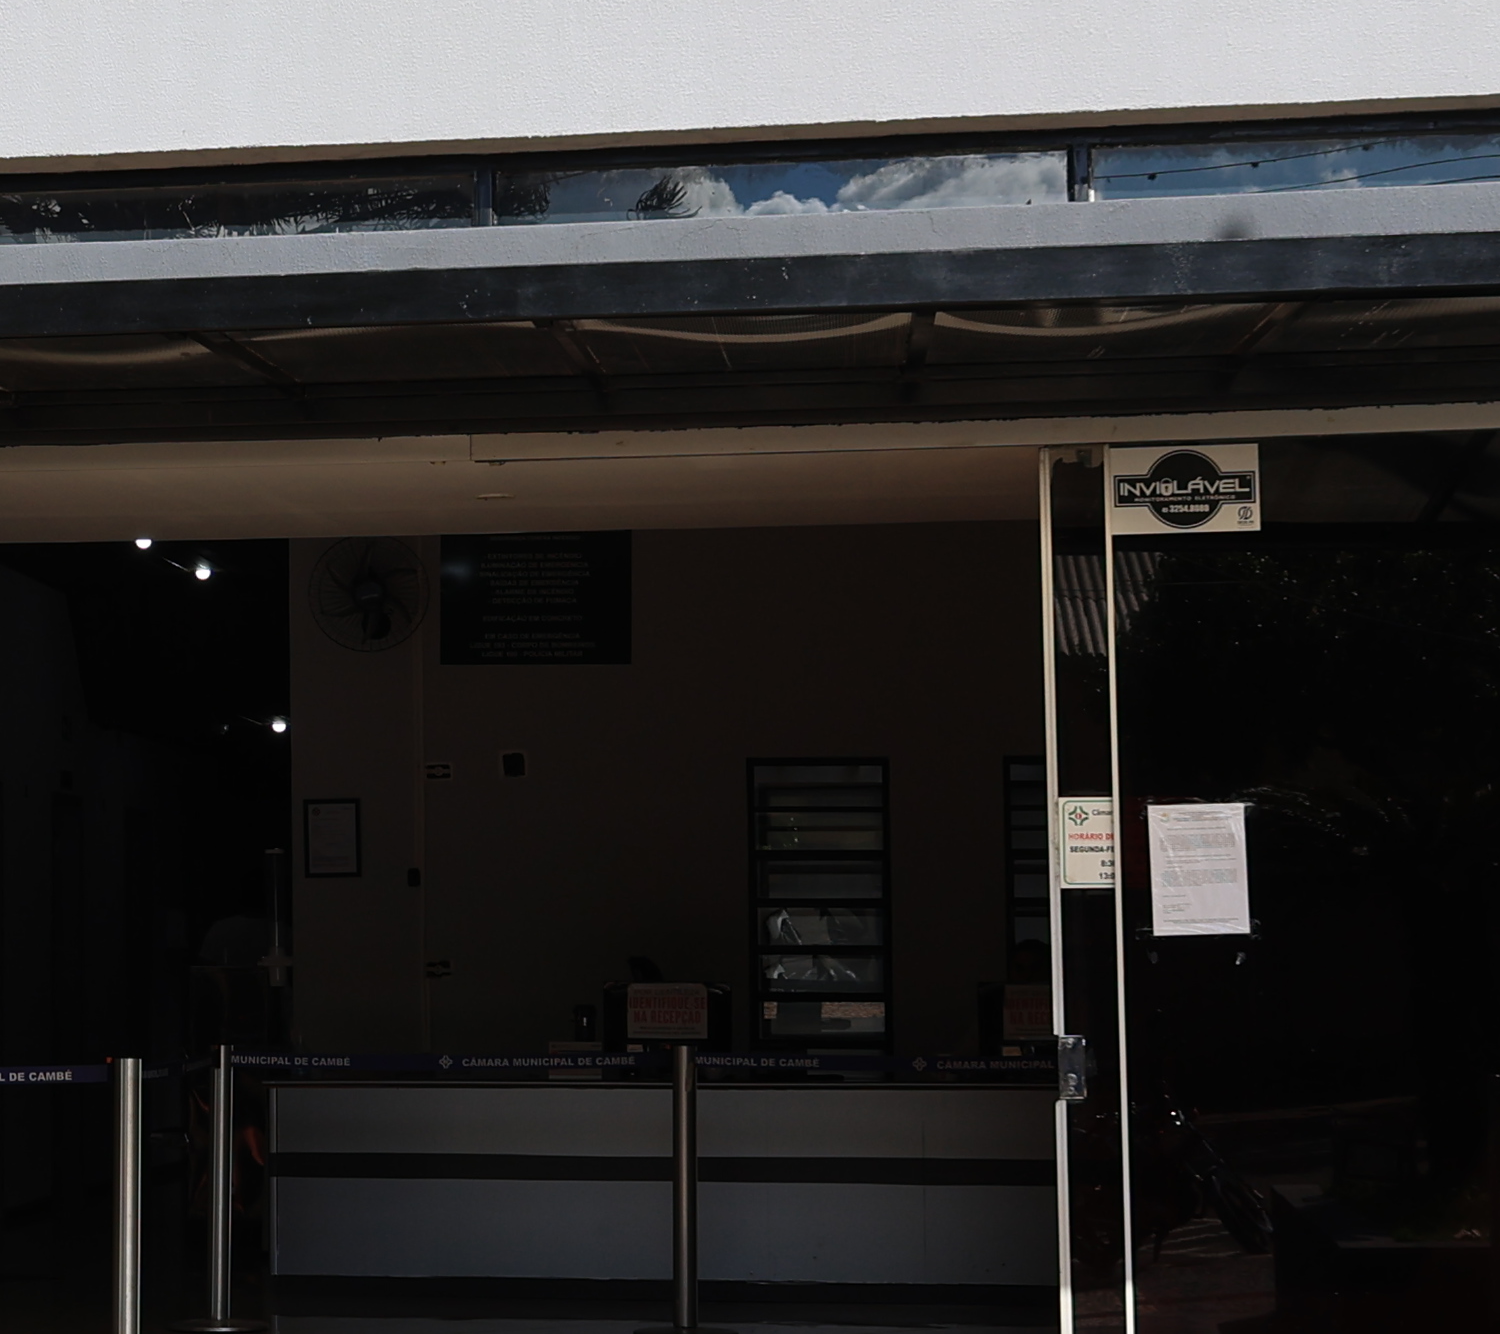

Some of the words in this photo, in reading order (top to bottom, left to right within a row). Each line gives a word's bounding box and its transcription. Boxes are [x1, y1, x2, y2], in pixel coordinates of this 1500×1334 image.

[1120, 476, 1250, 496] INVIOLÁVEL
[1068, 832, 1103, 840] HORÁRIO
[634, 1010, 647, 1023] NA
[231, 1055, 291, 1066] MUNICIPAL
[295, 1056, 309, 1066] DE
[312, 1055, 350, 1066] CAMBÉ
[462, 1056, 509, 1067] CÂMARA
[513, 1057, 574, 1066] MUNICIPAL
[578, 1057, 592, 1066] DE
[596, 1055, 635, 1066] CAMBÉ
[695, 1056, 757, 1066] MUNICIPAL
[761, 1057, 775, 1066] DE
[779, 1057, 820, 1067] CAMBÉ
[937, 1059, 986, 1069] CÂMARA
[990, 1060, 1055, 1069] MUNICIPAL
[9, 1071, 25, 1082] DE
[29, 1068, 72, 1082] CAMBÉ
